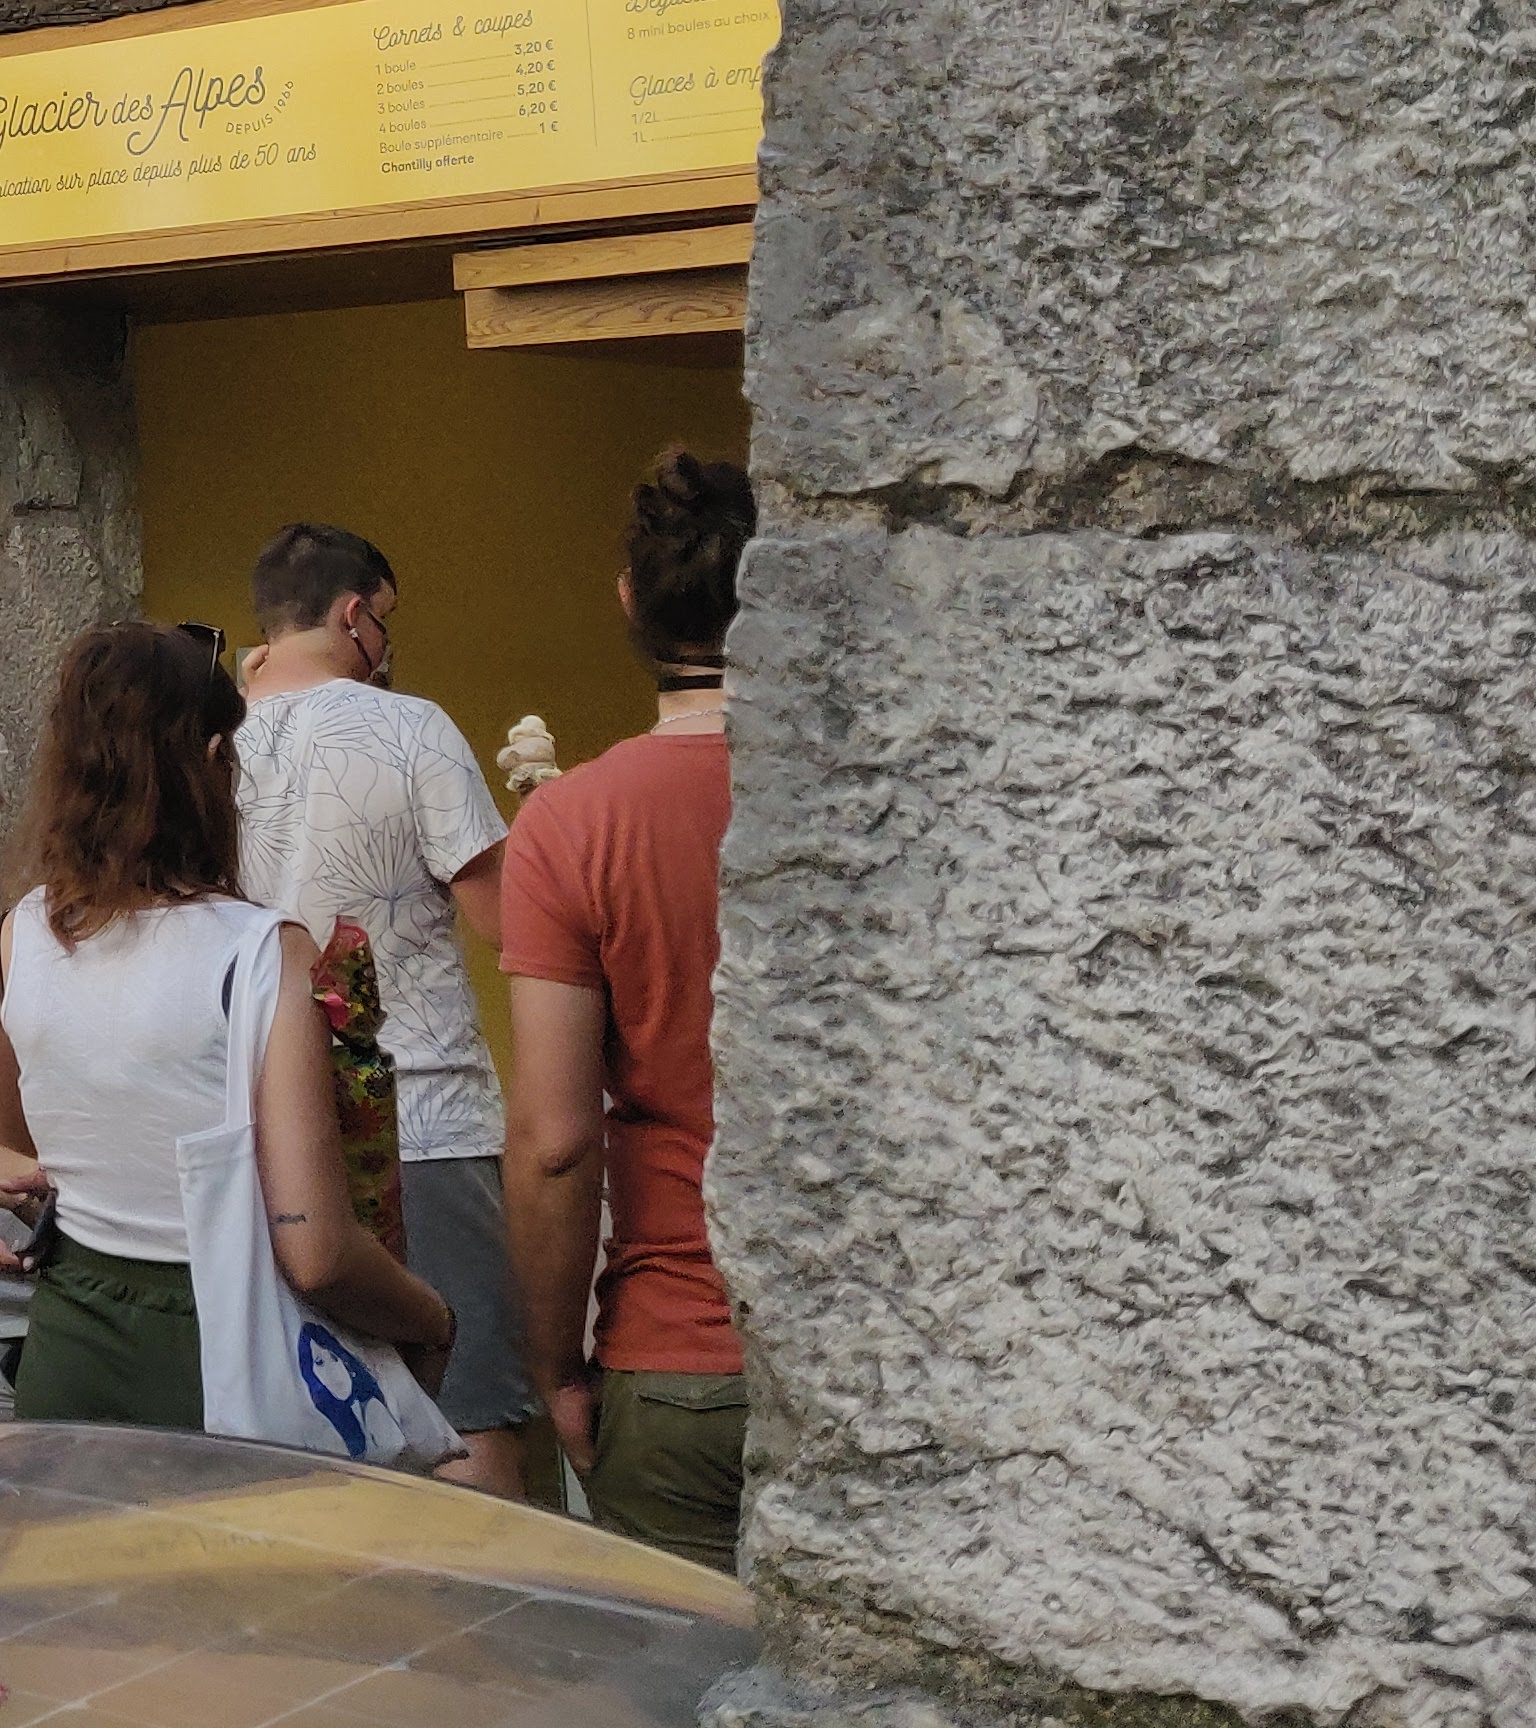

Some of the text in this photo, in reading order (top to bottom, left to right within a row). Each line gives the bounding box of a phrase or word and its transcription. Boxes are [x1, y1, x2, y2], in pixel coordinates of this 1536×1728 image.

[373, 9, 534, 53] Cornets & coupes
[627, 12, 770, 40] 8 mini boules au choix
[376, 38, 555, 76] 1 boule 3,20 €
[377, 59, 556, 95] 2 boules 4,20 €
[629, 73, 696, 106] Glaces
[705, 65, 719, 88] à
[112, 93, 154, 125] des
[127, 66, 266, 156] Alpes
[377, 78, 557, 115] 3 boules 5,20 €
[225, 113, 274, 135] DEPUIS
[379, 100, 558, 134] 4 boules 6,20 €
[631, 111, 661, 125] 1/2L
[379, 120, 558, 155] Boule supplémentaire 1 €
[632, 131, 648, 143] 1L
[56, 174, 83, 192] sur
[86, 165, 130, 194] place
[133, 160, 184, 188] depuis
[188, 153, 223, 182] plus
[230, 149, 251, 170] de
[255, 142, 279, 167] 50
[286, 142, 318, 164] ans
[381, 152, 475, 175] Chantilly offerte
